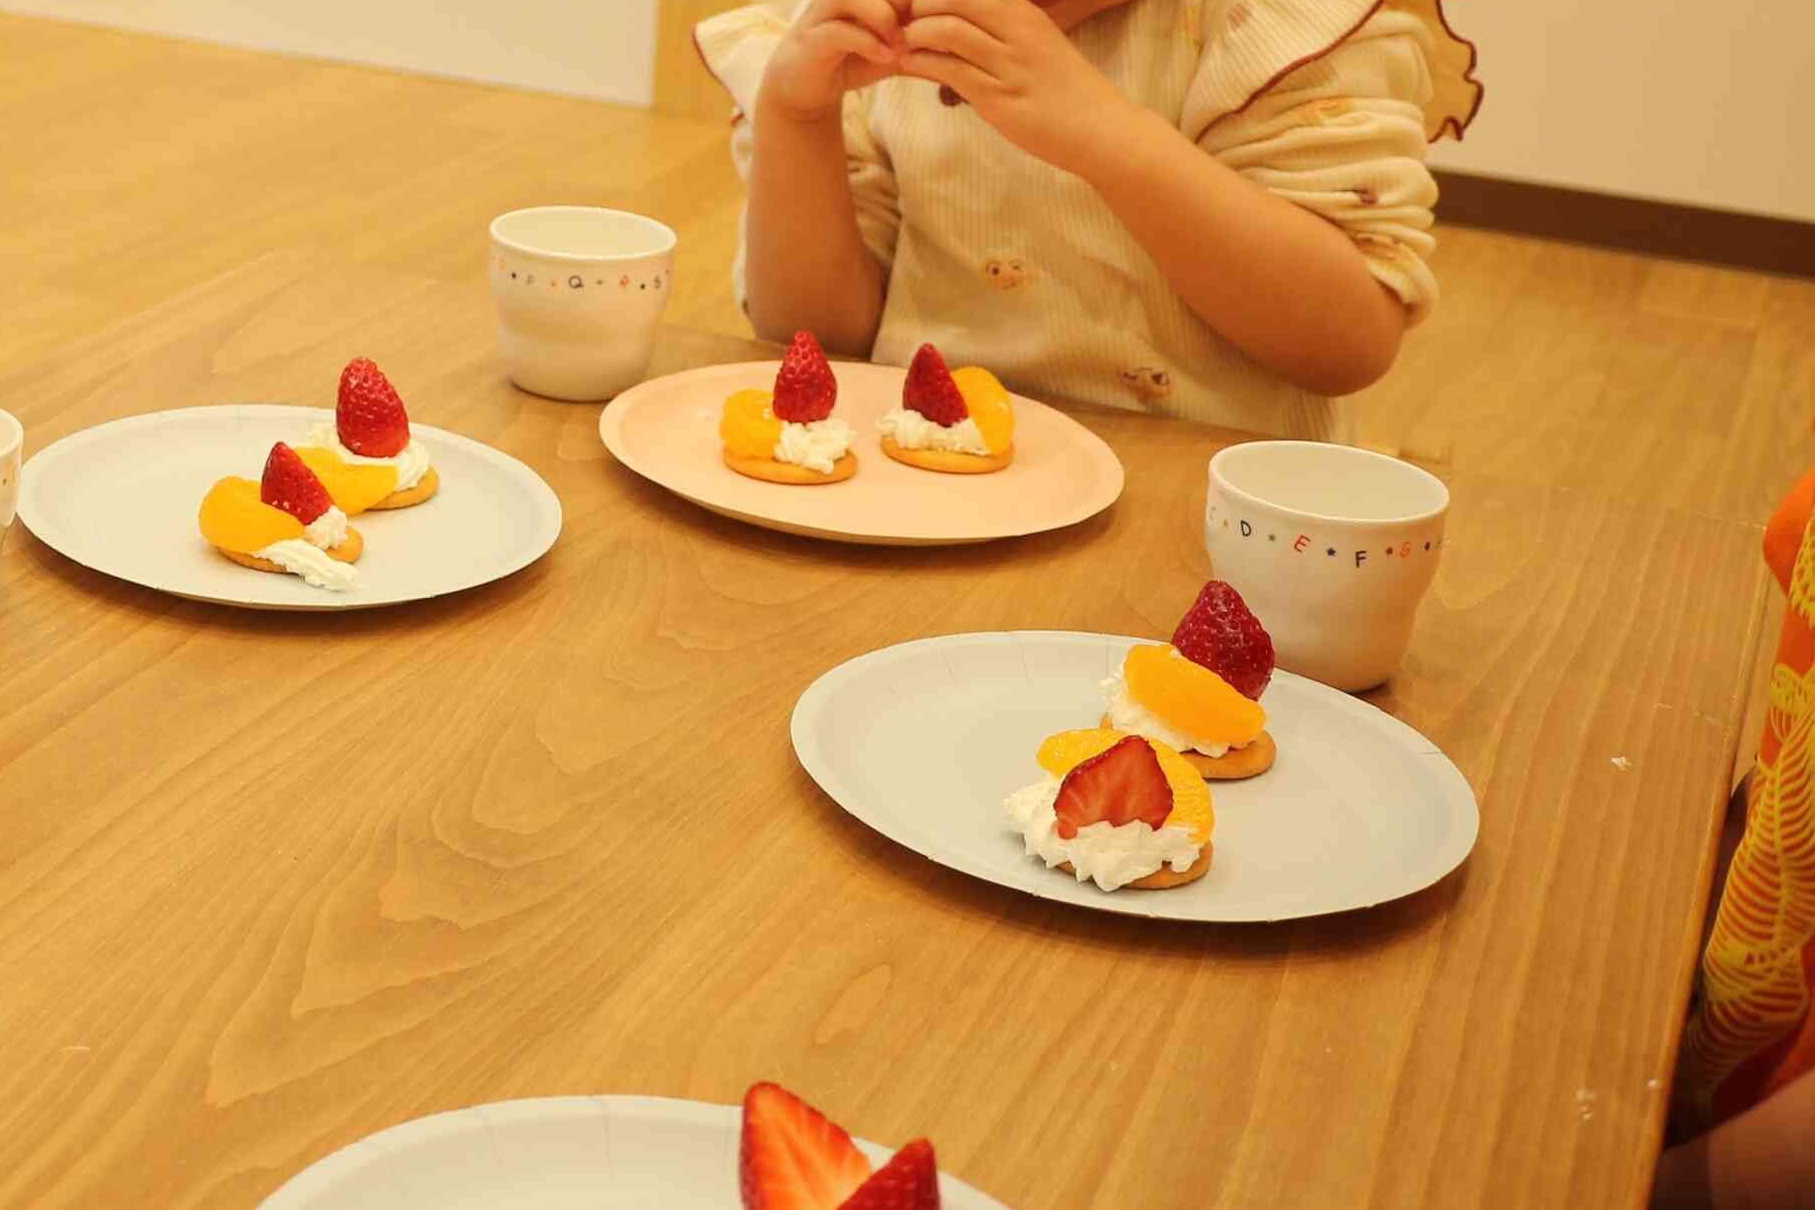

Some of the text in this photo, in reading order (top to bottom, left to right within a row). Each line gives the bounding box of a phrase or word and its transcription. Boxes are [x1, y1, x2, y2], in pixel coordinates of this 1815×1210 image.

[1240, 520, 1253, 537] D
[1294, 534, 1311, 553] E
[1355, 550, 1367, 569] F
